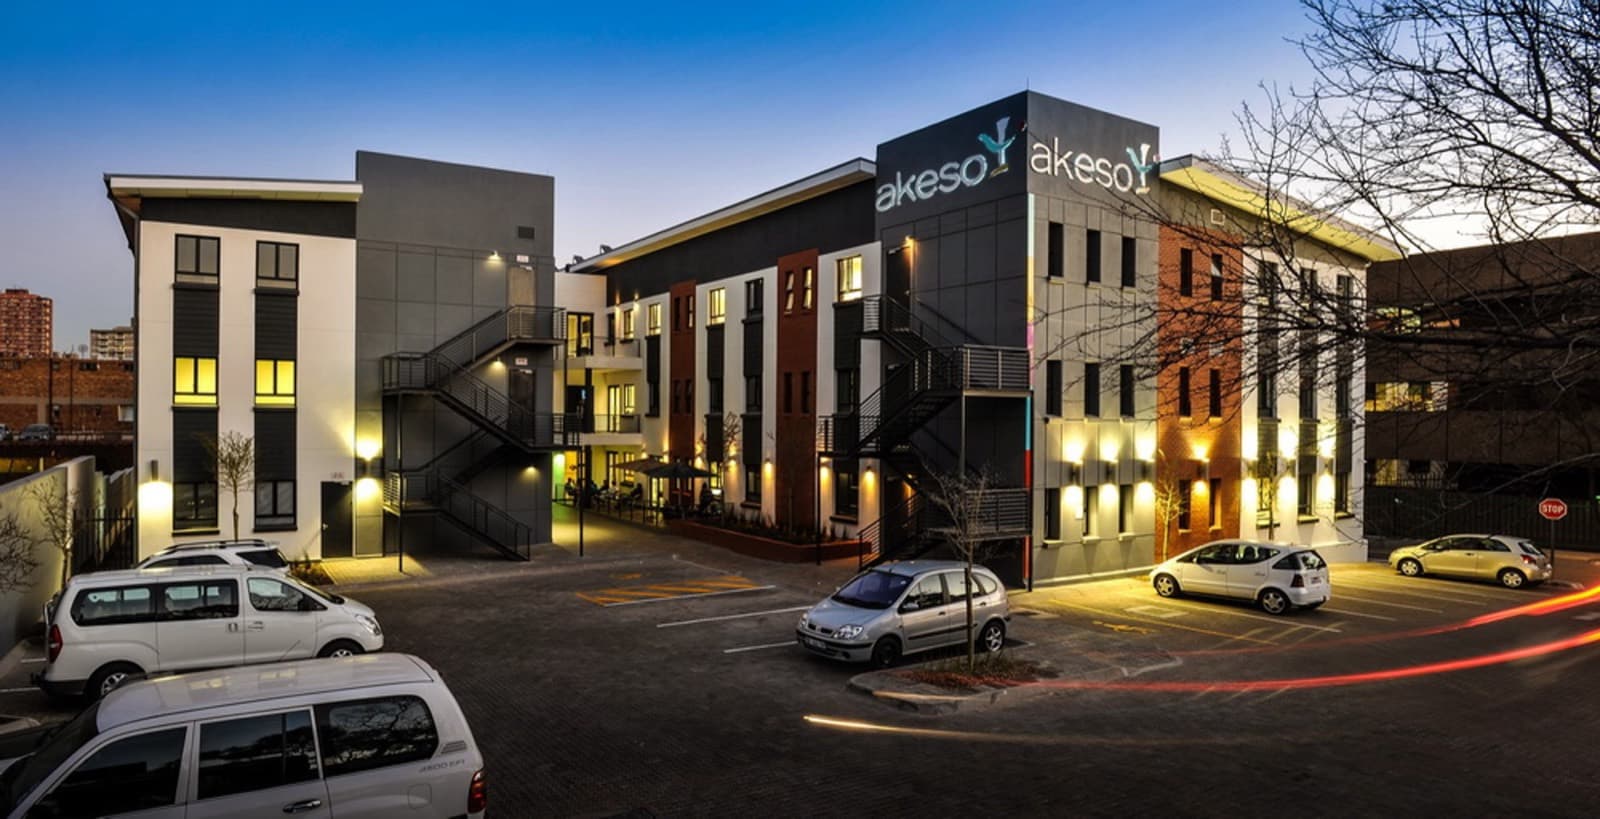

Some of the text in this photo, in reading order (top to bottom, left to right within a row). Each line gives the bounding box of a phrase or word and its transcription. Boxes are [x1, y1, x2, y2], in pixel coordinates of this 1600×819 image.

[875, 154, 988, 212] akeso
[1030, 137, 1133, 192] akeso
[1542, 504, 1564, 513] STOP
